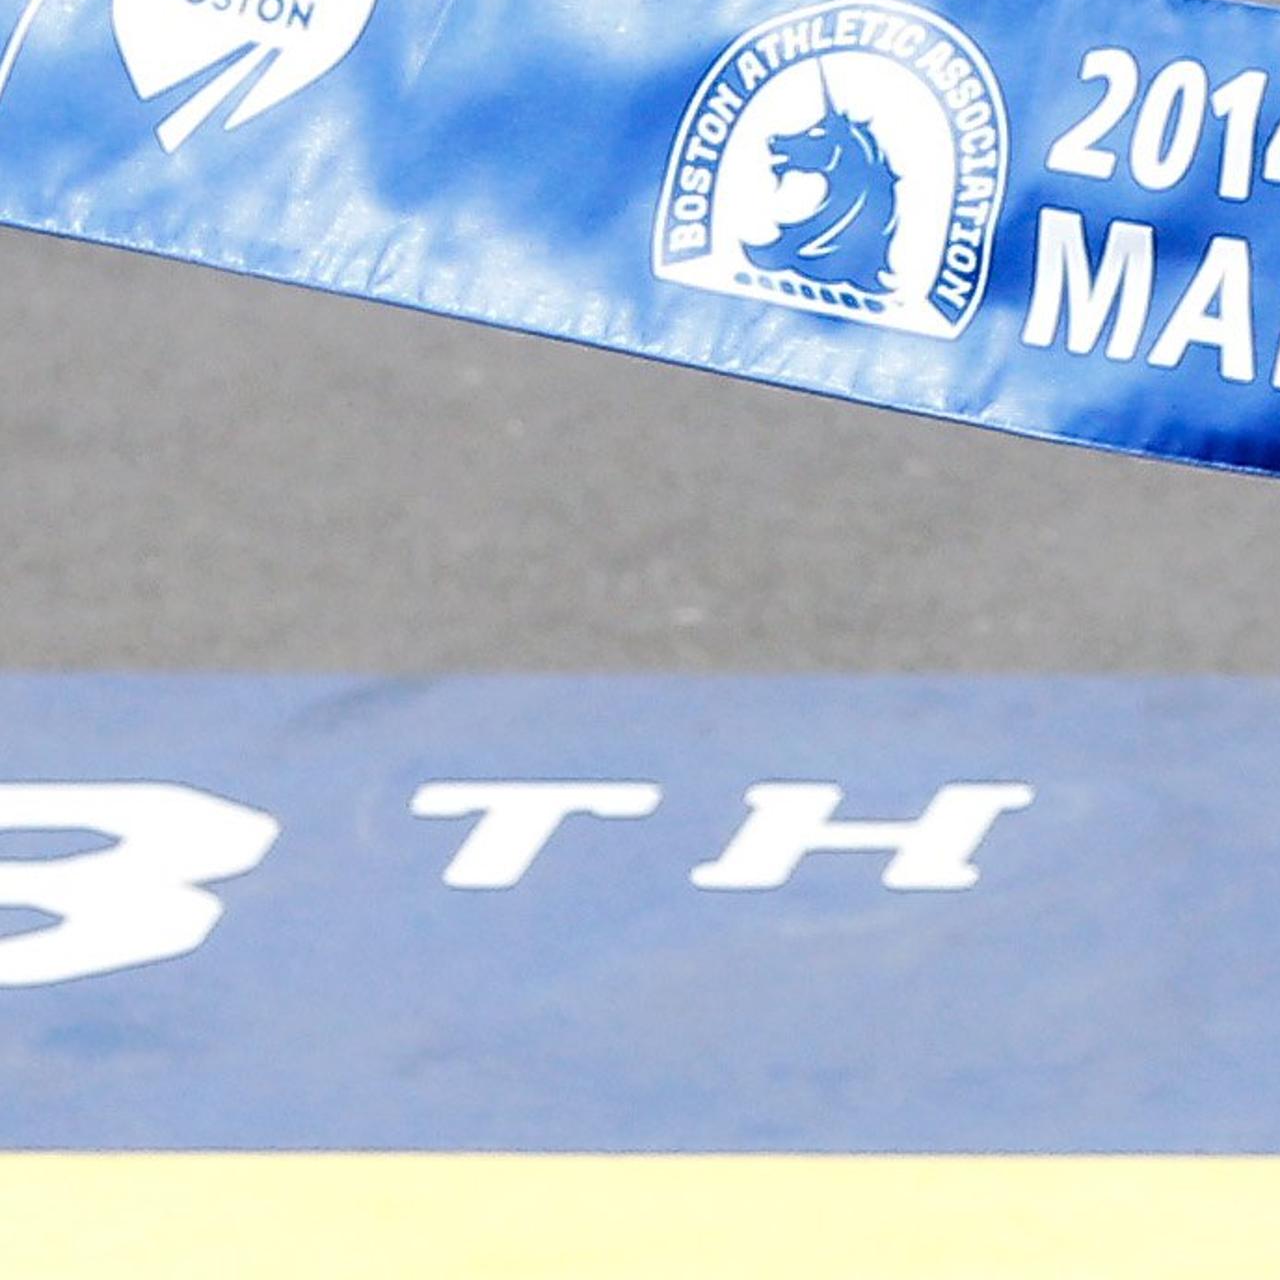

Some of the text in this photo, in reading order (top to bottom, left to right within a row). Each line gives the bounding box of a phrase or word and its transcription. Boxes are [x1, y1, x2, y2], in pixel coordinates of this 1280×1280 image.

[668, 9, 998, 312] BOSTON ATHLETIC ASSOCIATION
